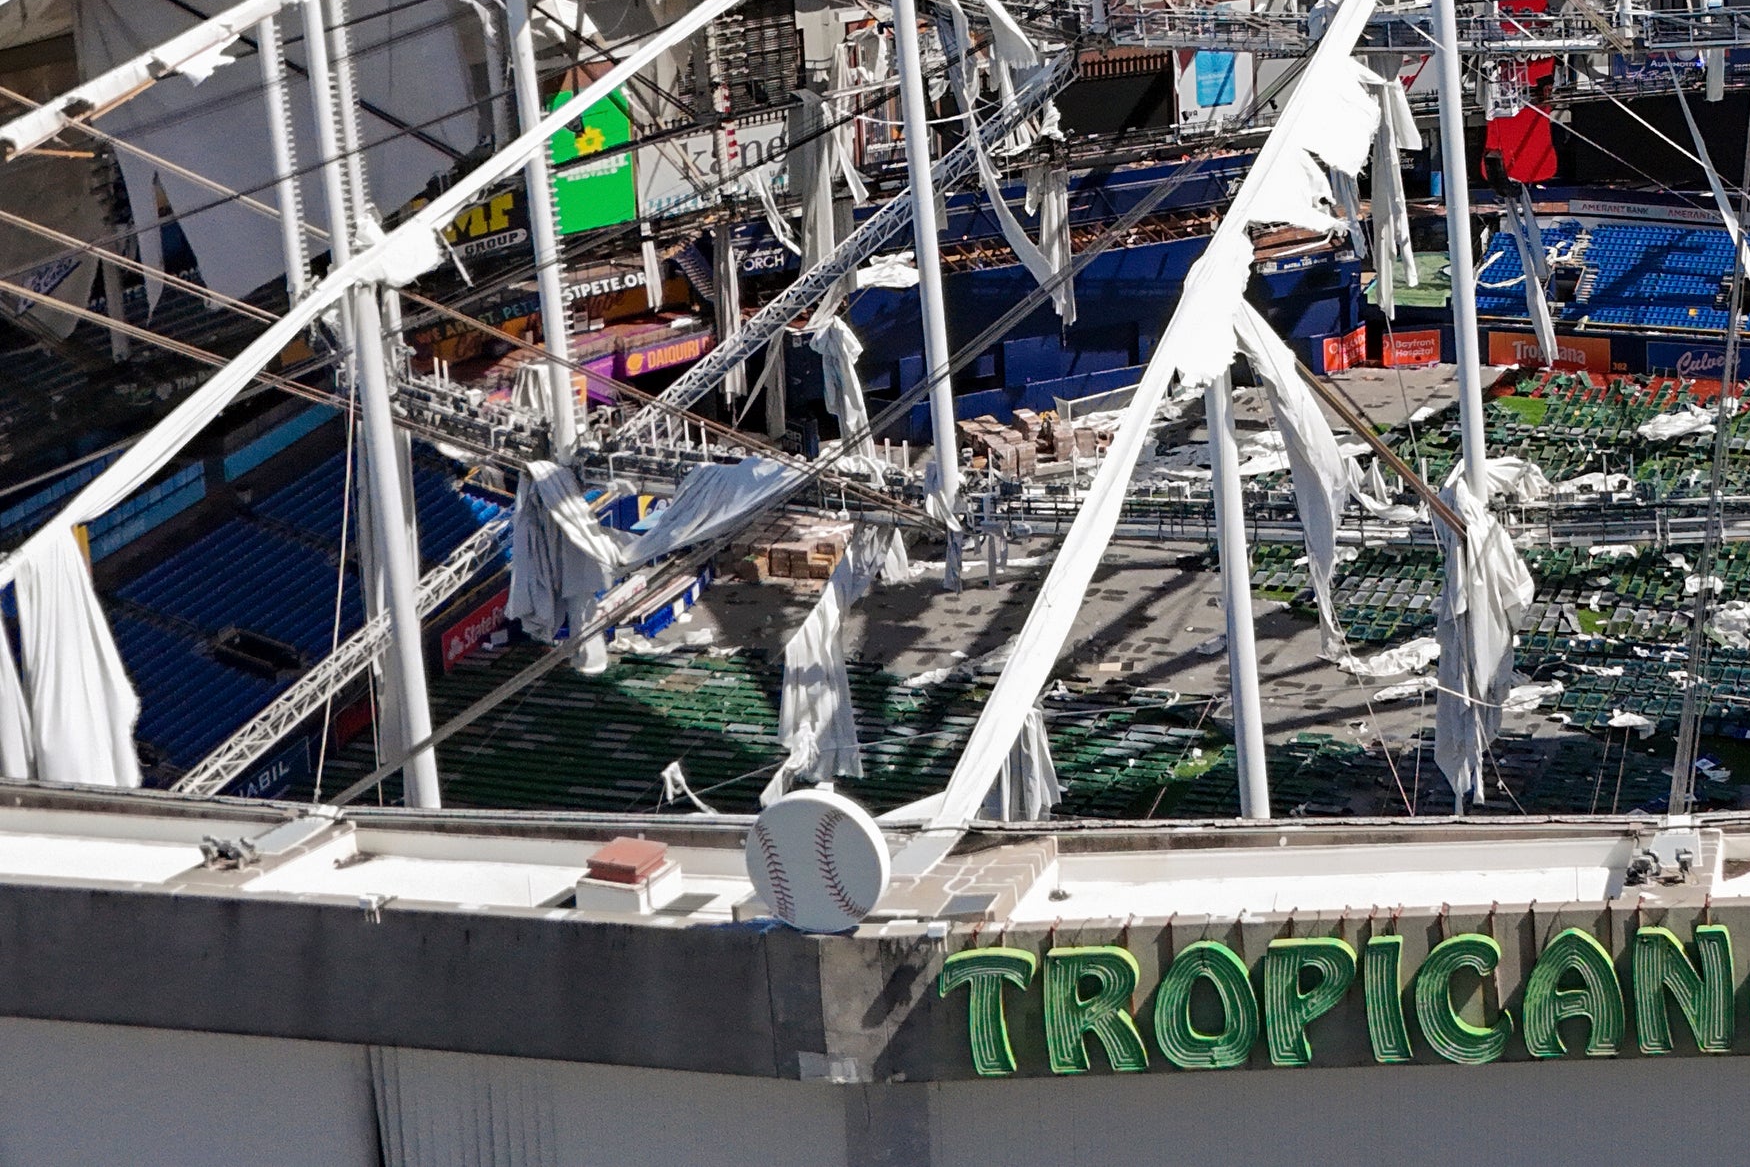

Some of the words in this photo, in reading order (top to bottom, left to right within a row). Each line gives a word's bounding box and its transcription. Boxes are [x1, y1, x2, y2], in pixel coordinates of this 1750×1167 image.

[1581, 203, 1625, 215] AMERANT
[1626, 206, 1649, 215] BANK
[1667, 208, 1712, 221] AMERANT
[464, 232, 519, 255] GROUP
[735, 254, 785, 271] PORCH
[1396, 338, 1435, 351] Bayfront
[647, 344, 700, 369] DAIQUIRI
[1396, 348, 1434, 360] Hospital
[1512, 340, 1586, 365] Tropana
